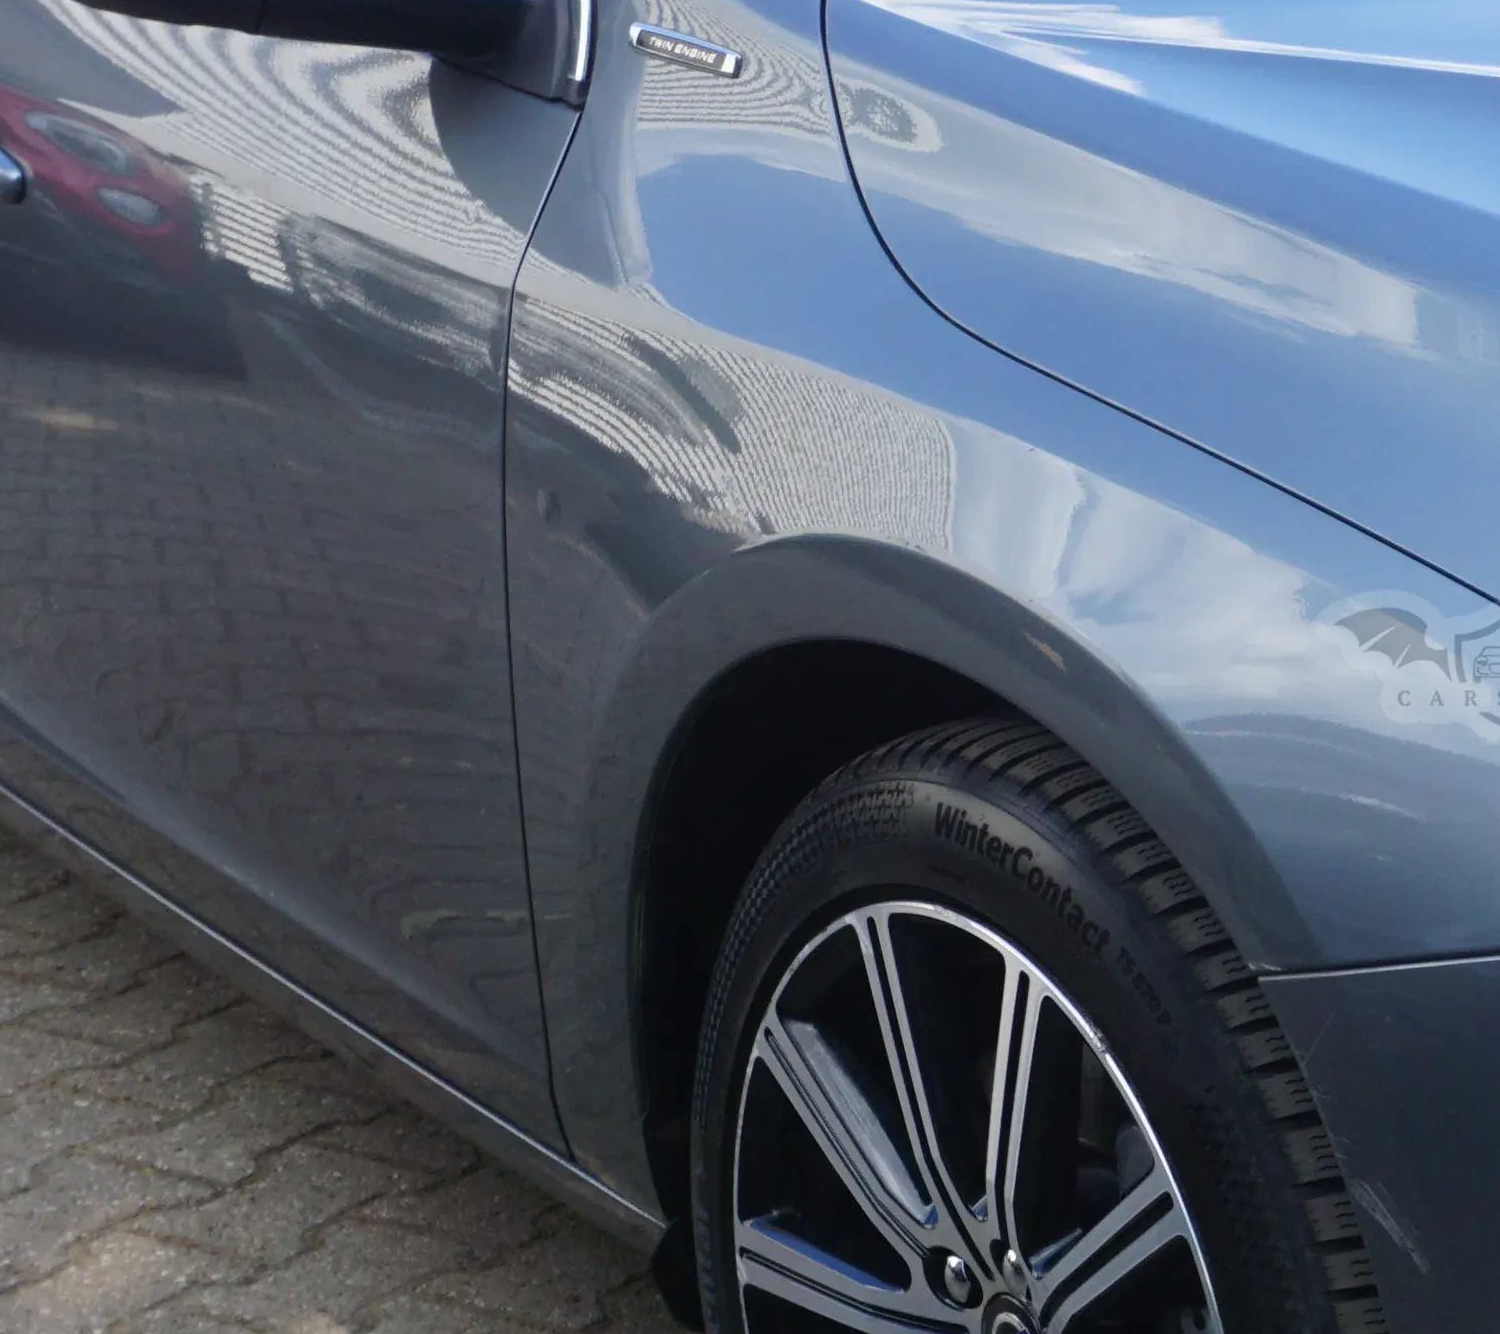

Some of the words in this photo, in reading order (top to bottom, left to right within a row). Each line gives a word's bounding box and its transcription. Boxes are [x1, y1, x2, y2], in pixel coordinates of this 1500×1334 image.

[648, 36, 673, 51] TWIN
[674, 44, 717, 64] ENGINE
[933, 800, 1112, 955] WinterContact
